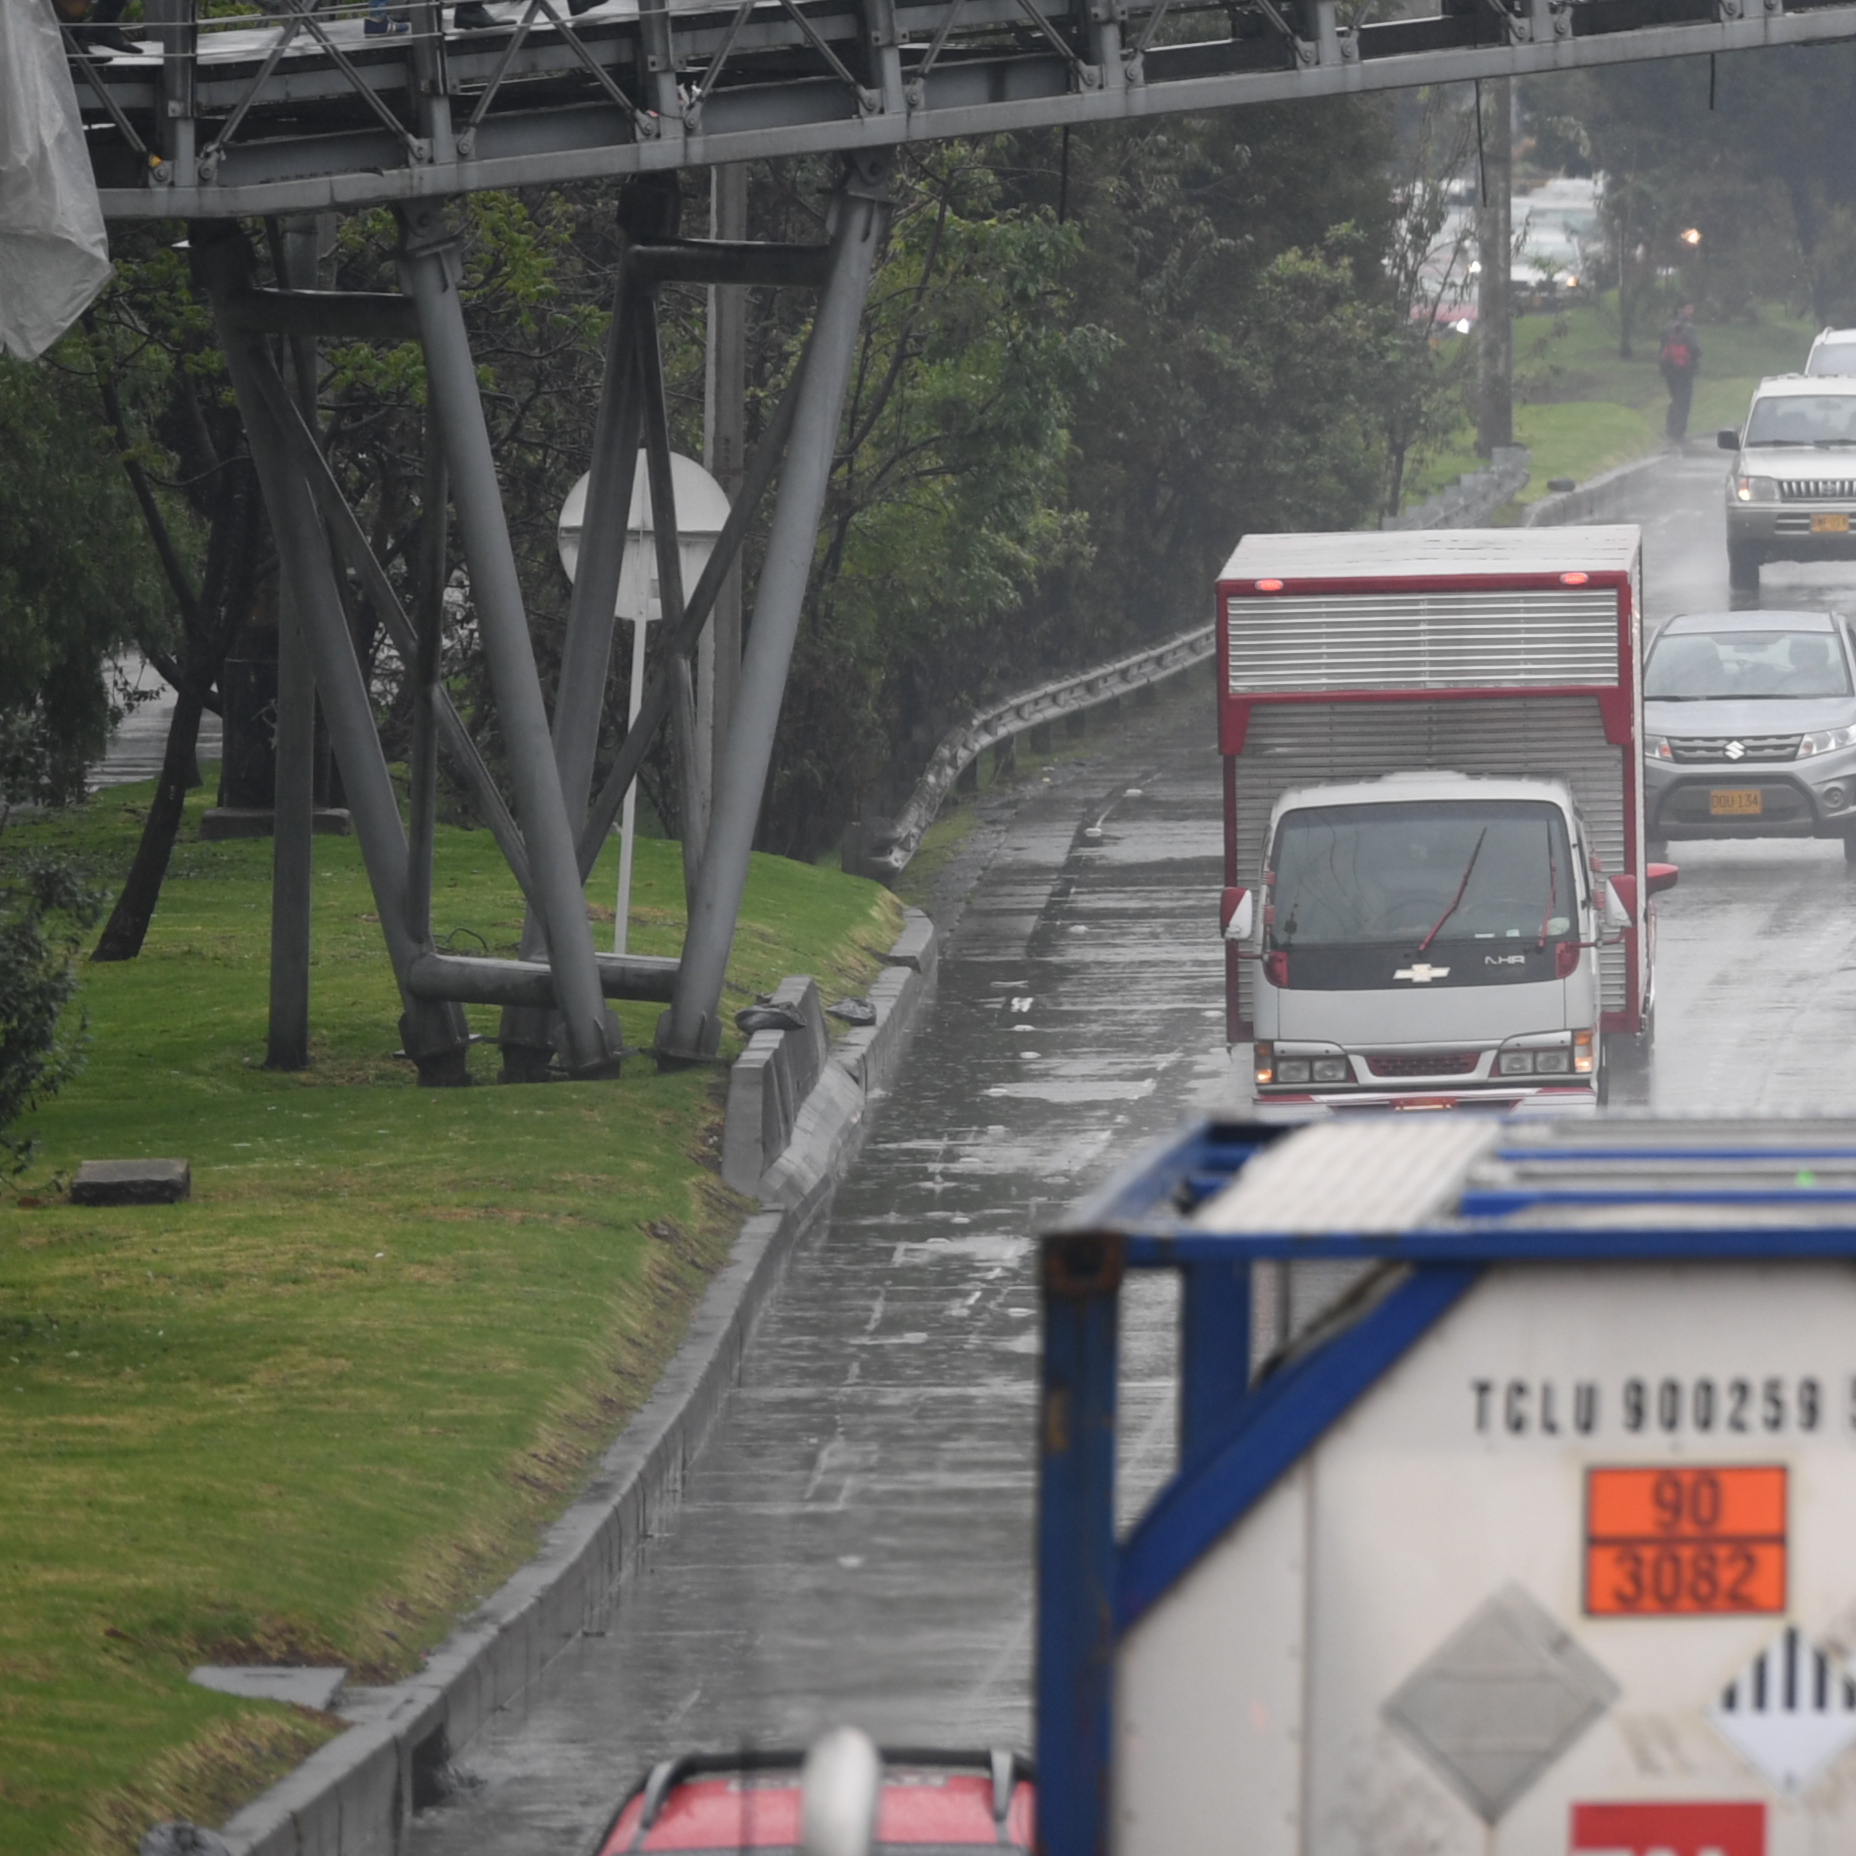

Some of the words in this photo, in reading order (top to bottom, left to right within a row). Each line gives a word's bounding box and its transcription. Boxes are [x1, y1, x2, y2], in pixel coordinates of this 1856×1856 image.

[1471, 1378, 1597, 1435] TCLU
[1623, 1376, 1822, 1434] 900259
[1652, 1471, 1721, 1531] 90
[1614, 1548, 1759, 1610] 3082
